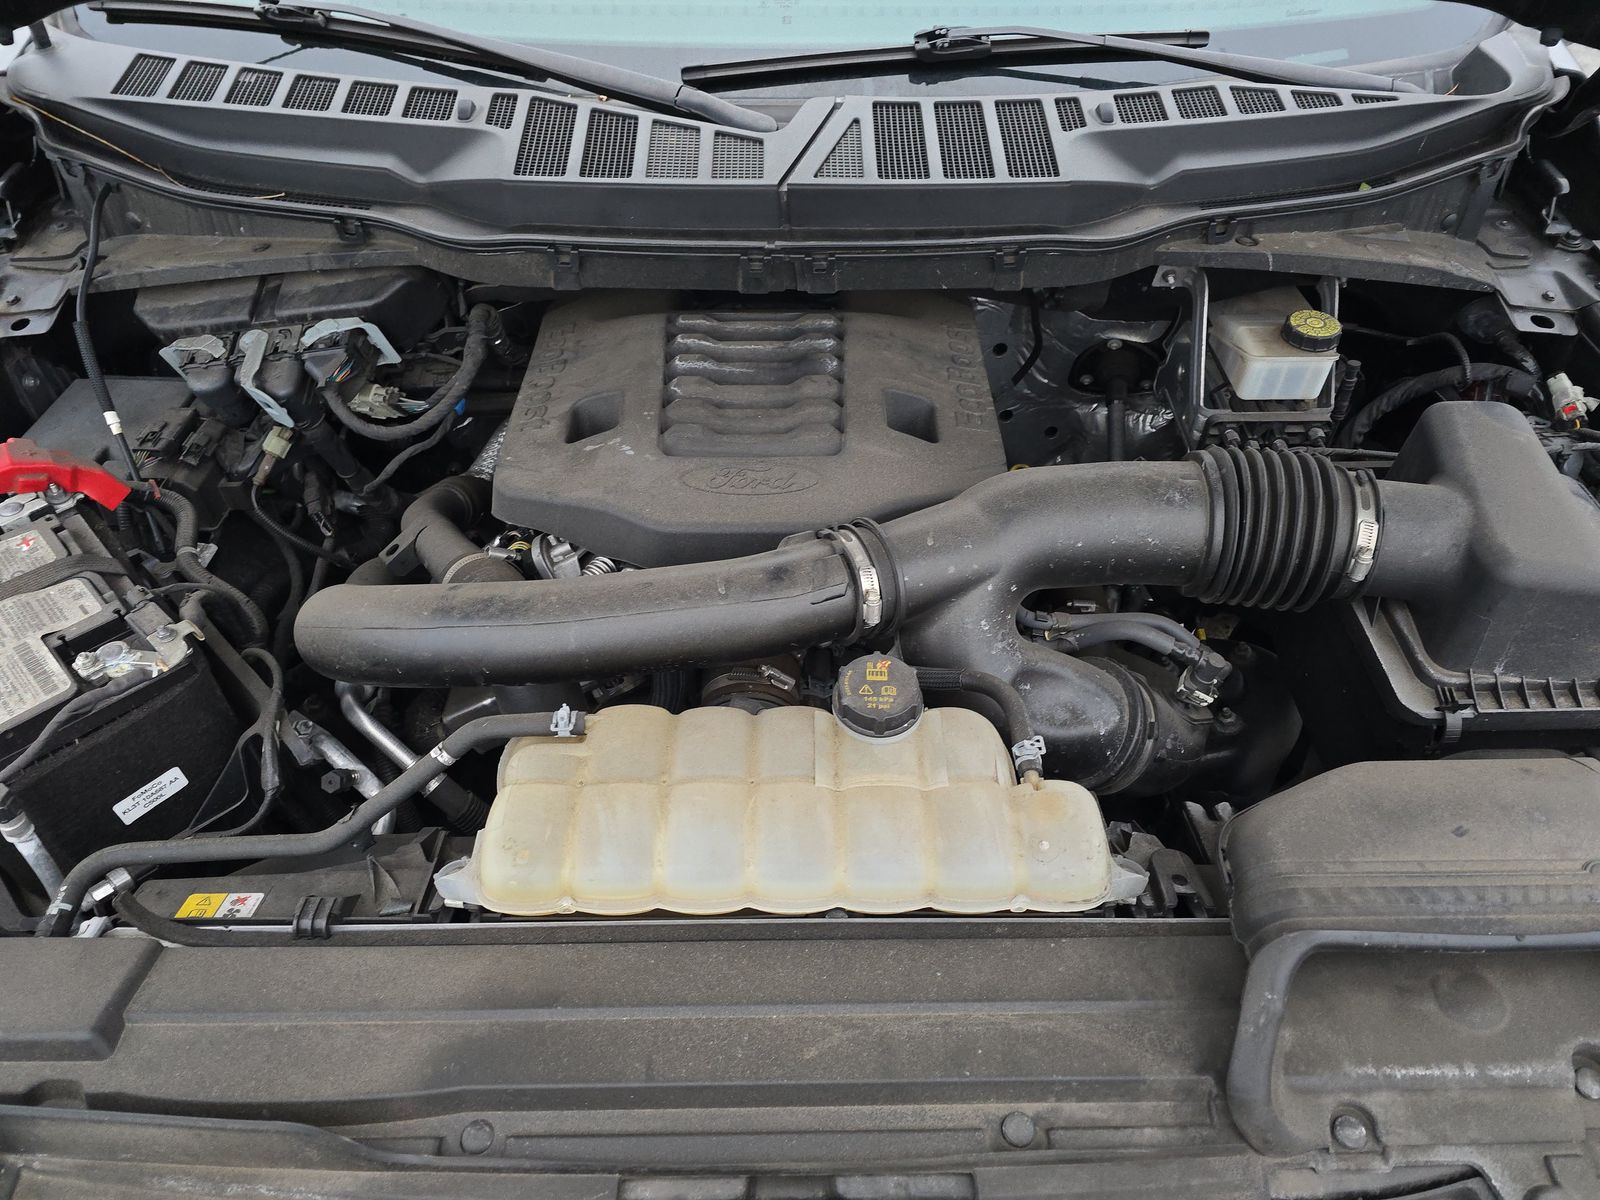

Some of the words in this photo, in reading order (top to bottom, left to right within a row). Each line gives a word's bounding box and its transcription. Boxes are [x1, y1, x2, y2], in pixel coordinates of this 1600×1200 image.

[706, 466, 797, 490] Ford
[132, 781, 161, 801] FoMoCo
[169, 777, 180, 786] AA
